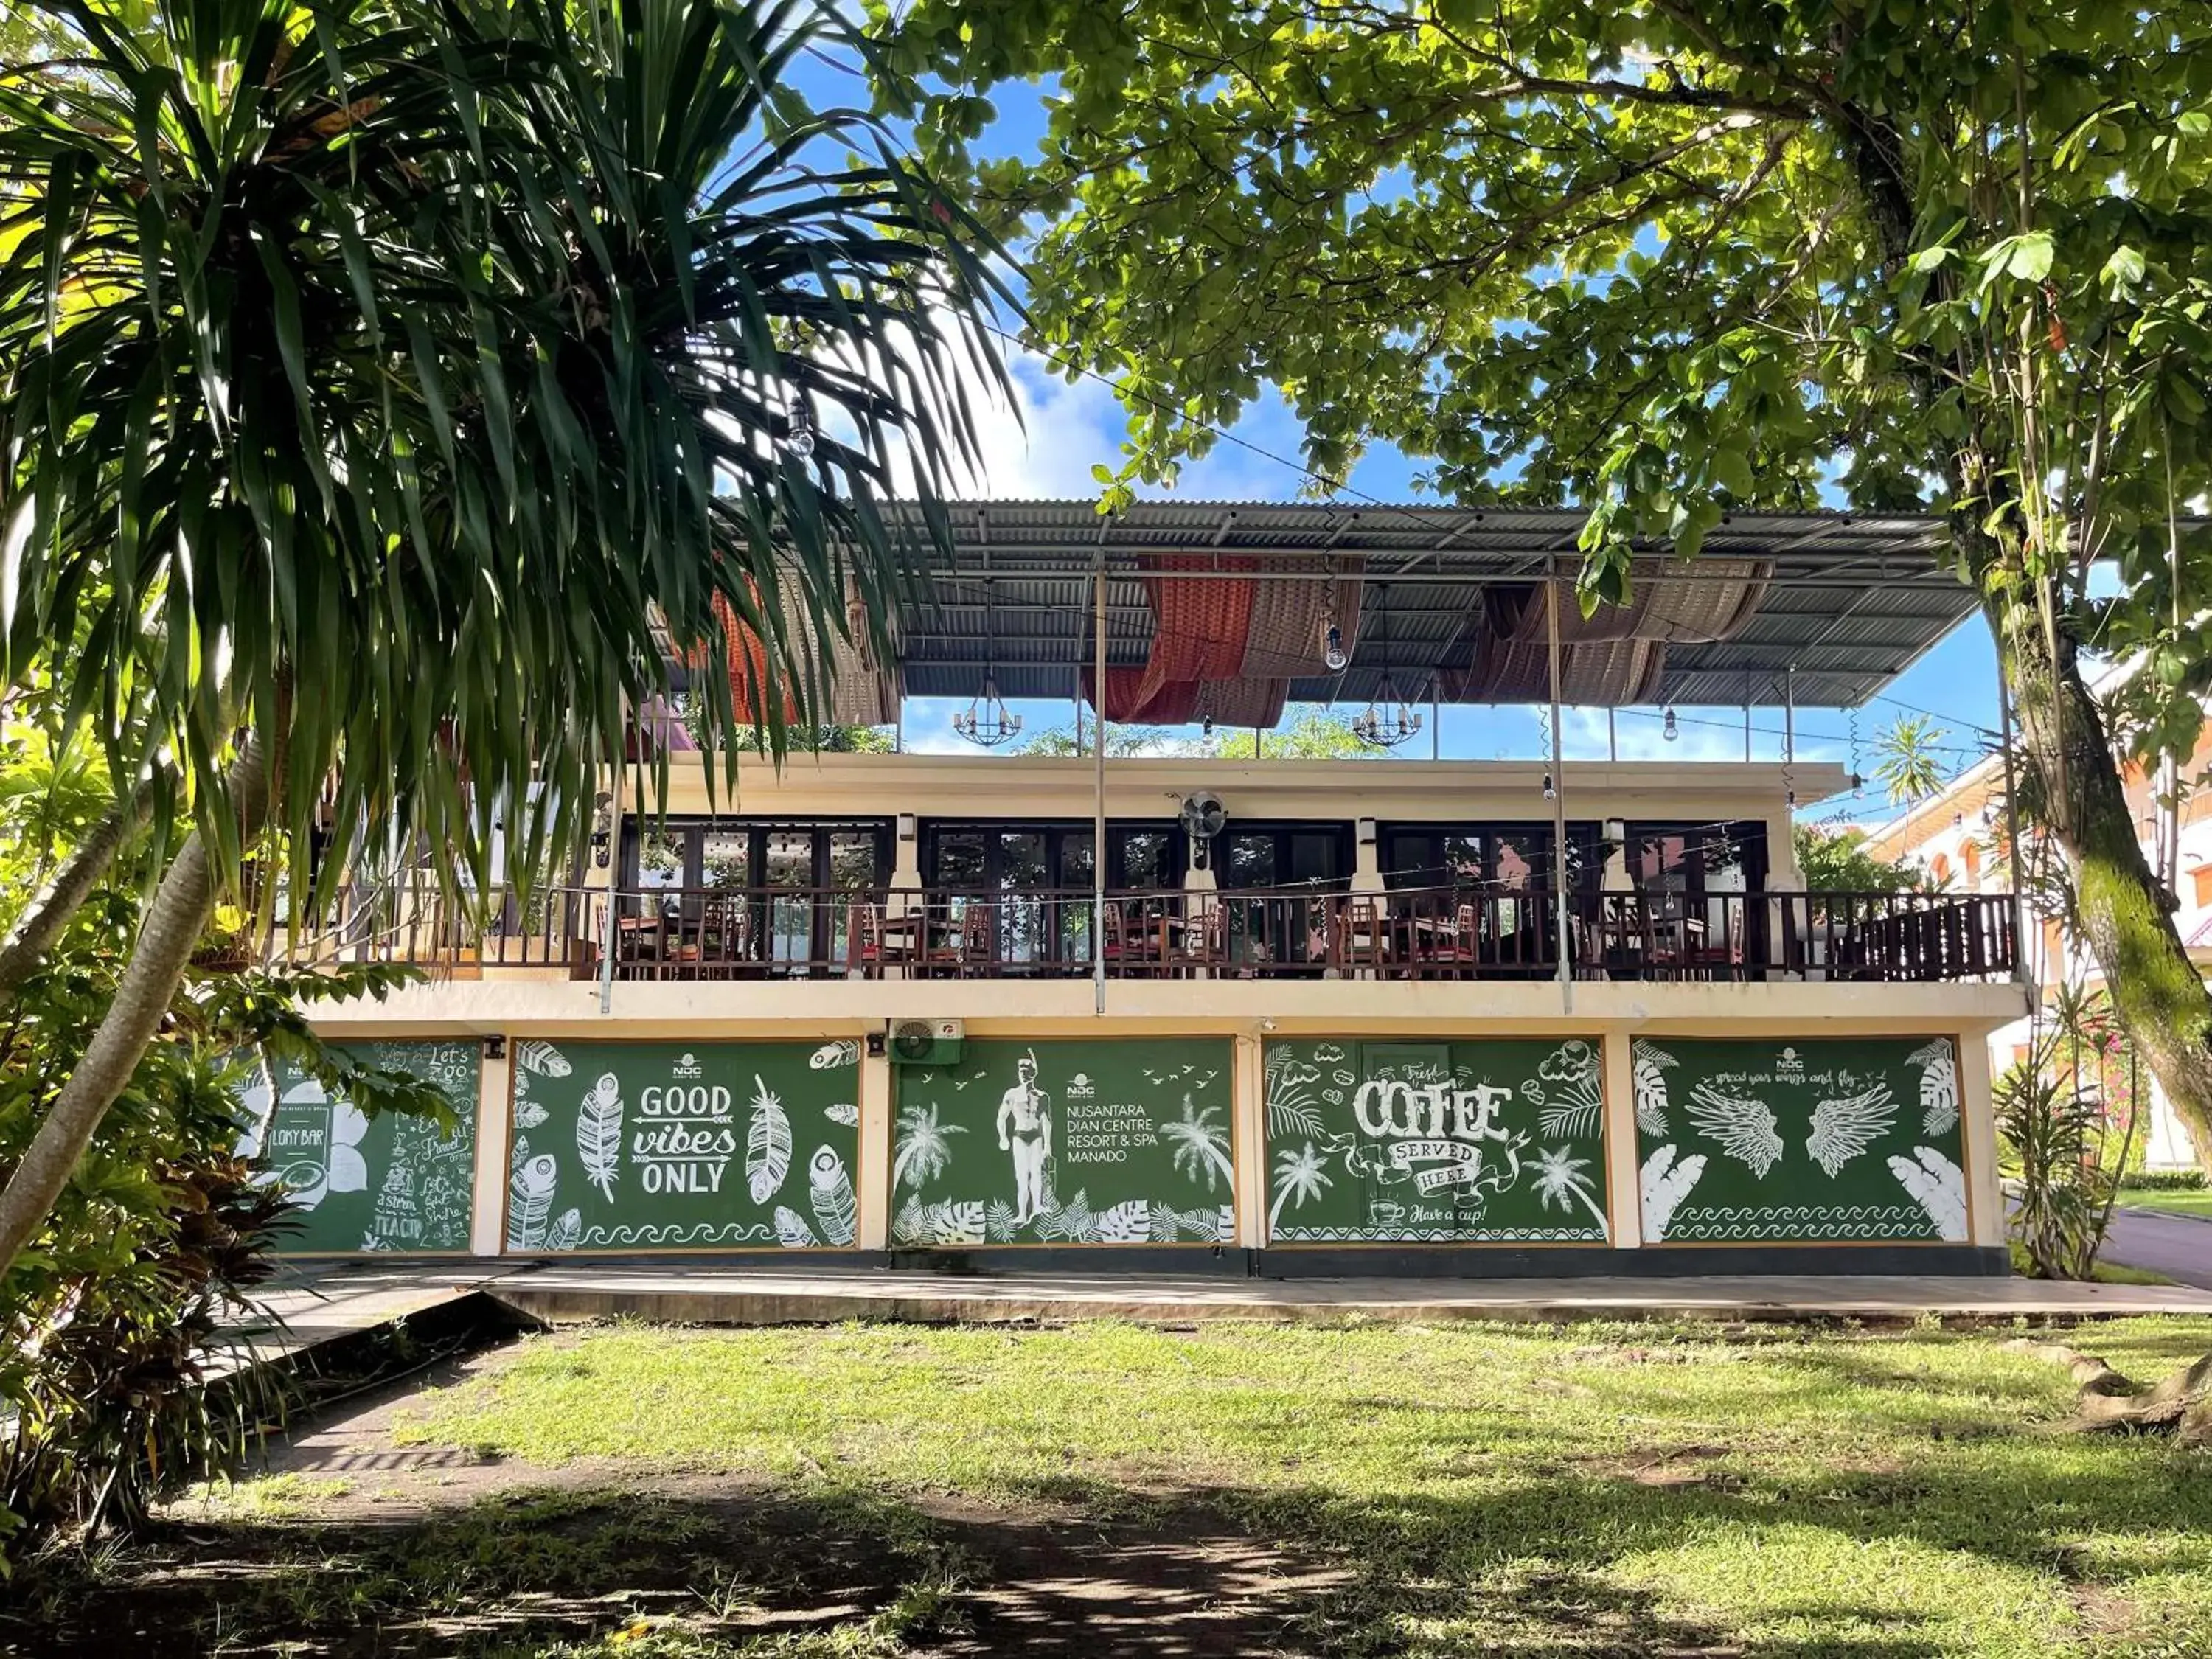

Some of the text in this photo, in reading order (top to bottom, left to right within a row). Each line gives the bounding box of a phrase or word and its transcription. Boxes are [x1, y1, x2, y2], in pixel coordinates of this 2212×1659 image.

[428, 1046, 468, 1065] Let's
[443, 1065, 467, 1085] go
[1809, 1069, 1832, 1085] and
[1067, 1086, 1095, 1095] NDC
[641, 1085, 731, 1116] GOOD
[1352, 1077, 1512, 1142] COFFEE
[1067, 1105, 1147, 1118] NUSANTARA
[1067, 1119, 1153, 1133] DIAN CENTRE
[300, 1129, 324, 1146] BAR
[633, 1121, 737, 1154] vibes
[1067, 1133, 1158, 1148] RESORT & SPA
[1067, 1150, 1127, 1163] MANADO
[1396, 1144, 1472, 1161] SERVED
[642, 1163, 726, 1194] ONLY
[1420, 1168, 1467, 1188] HERE
[1409, 1204, 1487, 1225] Have a cup!
